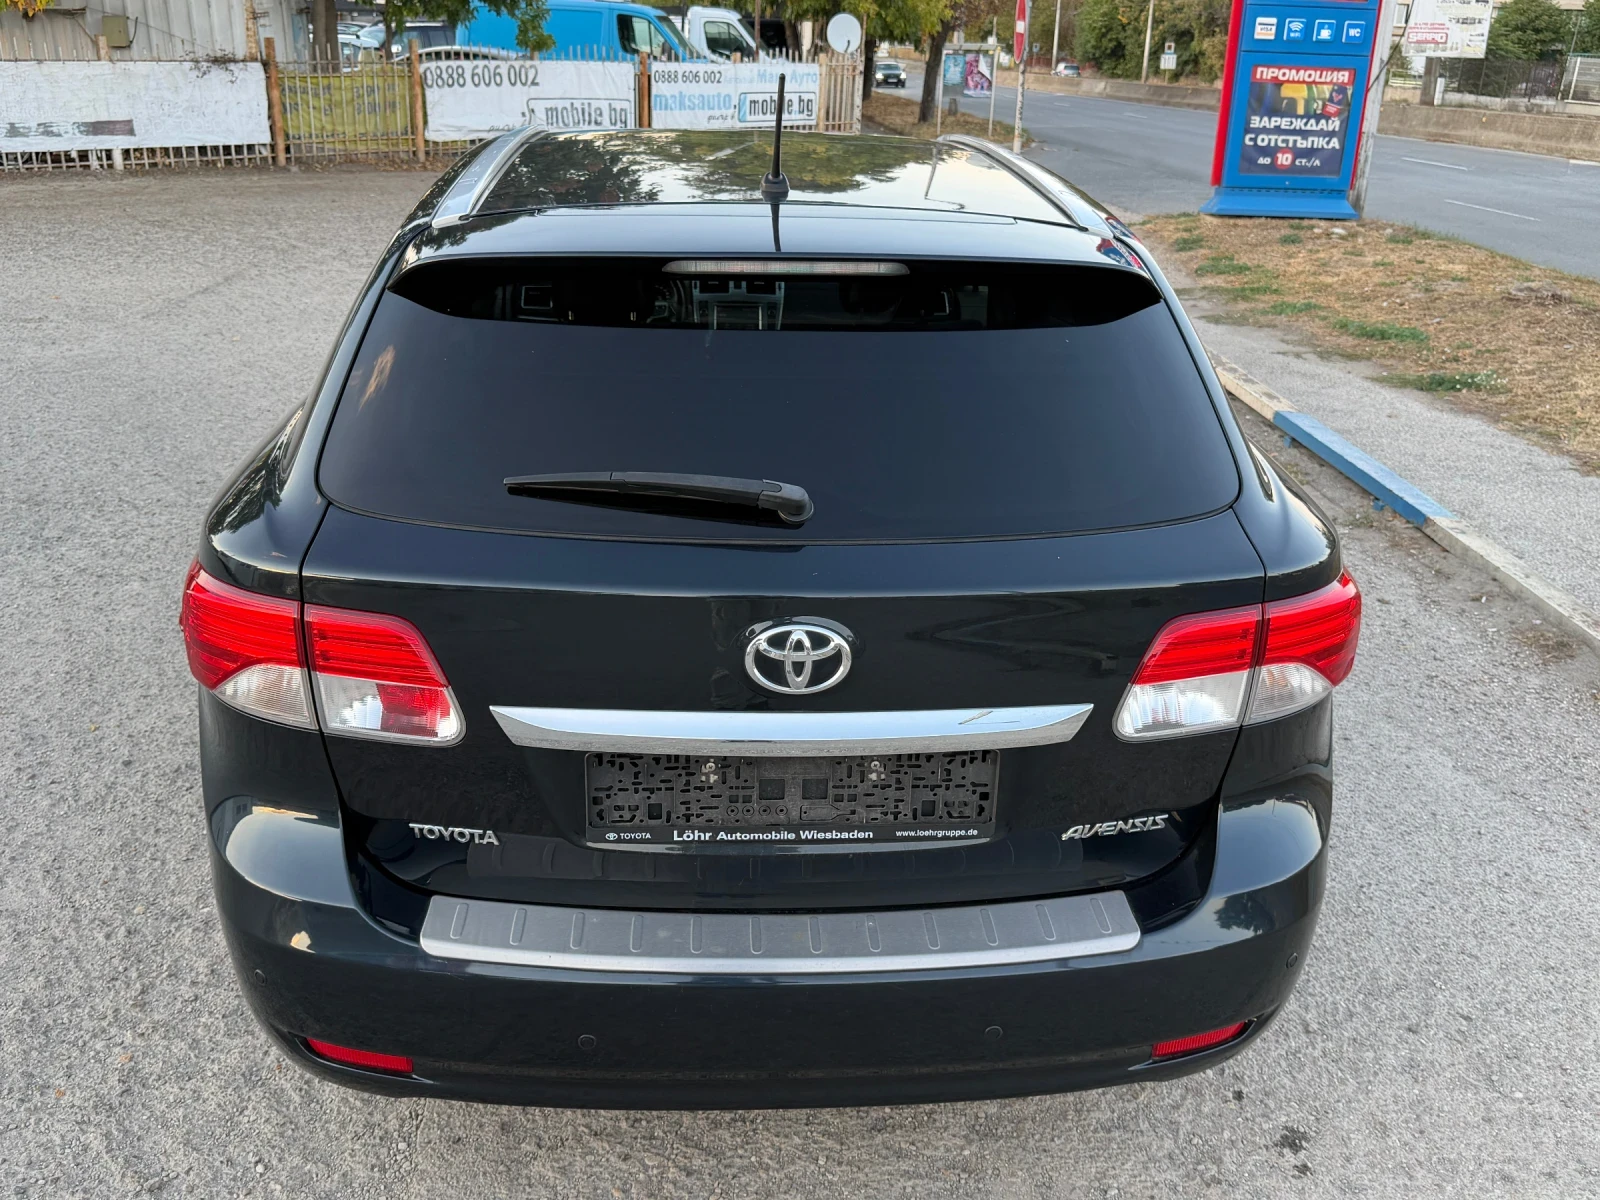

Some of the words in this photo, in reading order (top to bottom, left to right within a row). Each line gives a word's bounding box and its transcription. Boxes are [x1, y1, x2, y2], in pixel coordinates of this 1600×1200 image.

[1348, 28, 1361, 37] WC
[424, 64, 467, 88] 0888
[471, 64, 503, 87] 606
[507, 64, 540, 87] 002
[681, 70, 701, 84] 606
[703, 70, 723, 84] 002
[1256, 66, 1349, 83] ПРОМОЦИЯ
[1250, 115, 1341, 131] ЗАРЕЖДАЙ
[1256, 134, 1340, 149] ОТСТЪПКА
[1276, 153, 1292, 165] 10
[408, 823, 499, 846] TOYOTA
[896, 828, 978, 838] www.loehrgruppe.de
[1061, 814, 1169, 841] AVENSIS
[619, 832, 652, 840] TOYOTA
[673, 829, 712, 841] Löhr
[716, 831, 796, 841] Automobile
[800, 830, 874, 840] Wiesbaden
